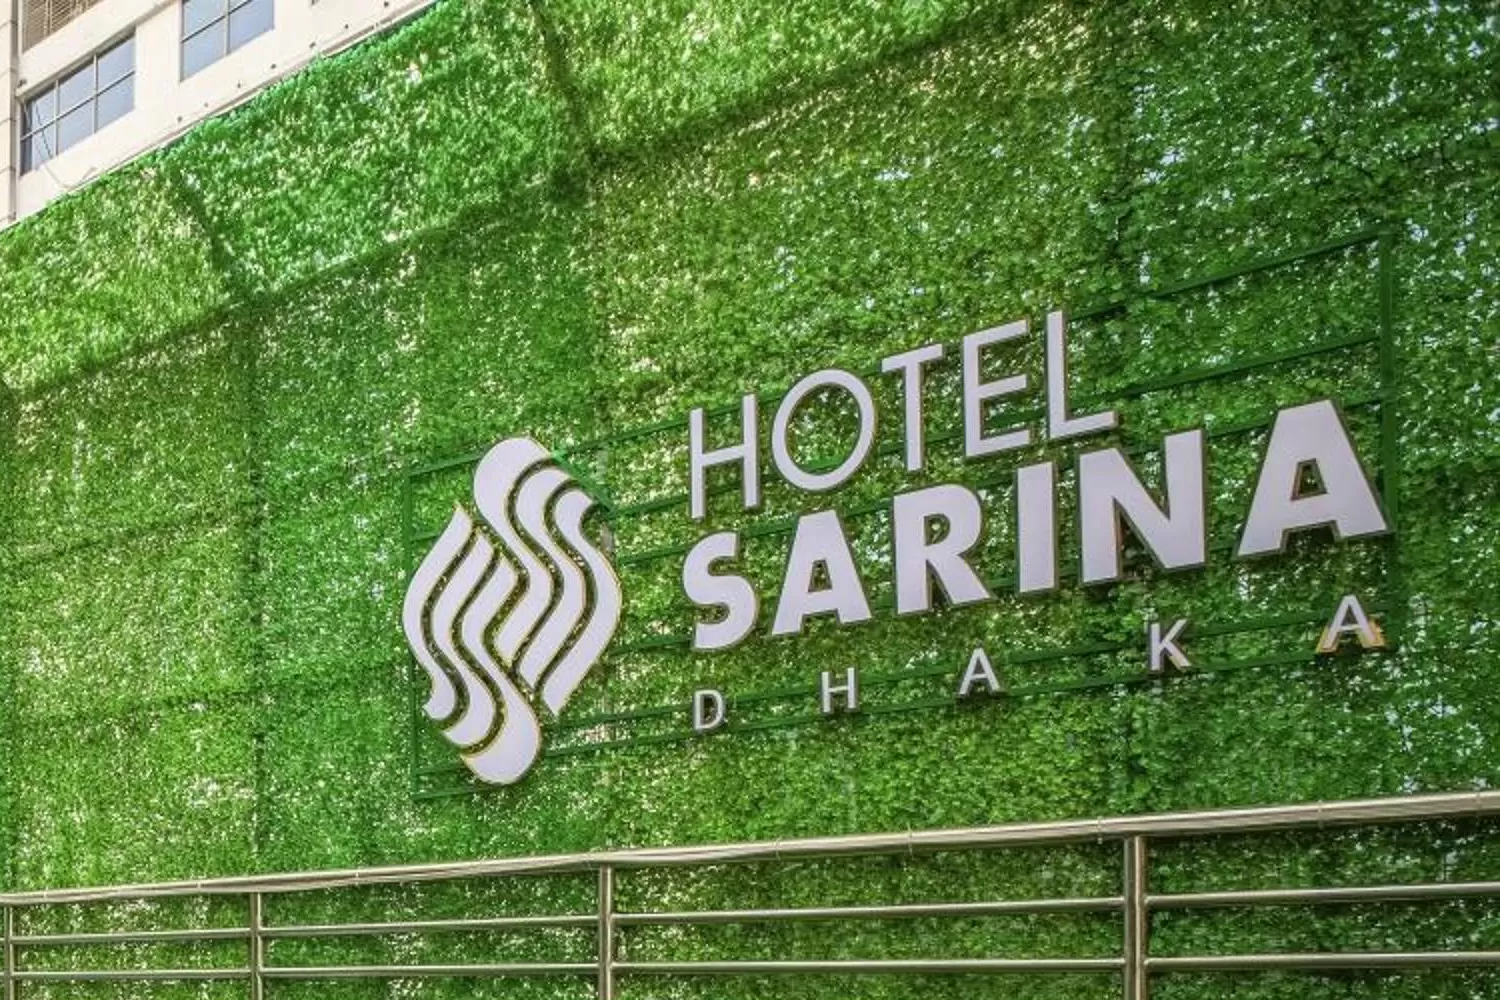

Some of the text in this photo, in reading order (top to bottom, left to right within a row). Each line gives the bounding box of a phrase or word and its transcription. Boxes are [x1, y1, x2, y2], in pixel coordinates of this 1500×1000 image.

[689, 310, 1116, 520] HOTEL
[682, 399, 1389, 651] SARINA
[693, 594, 1385, 732] DHAKA
